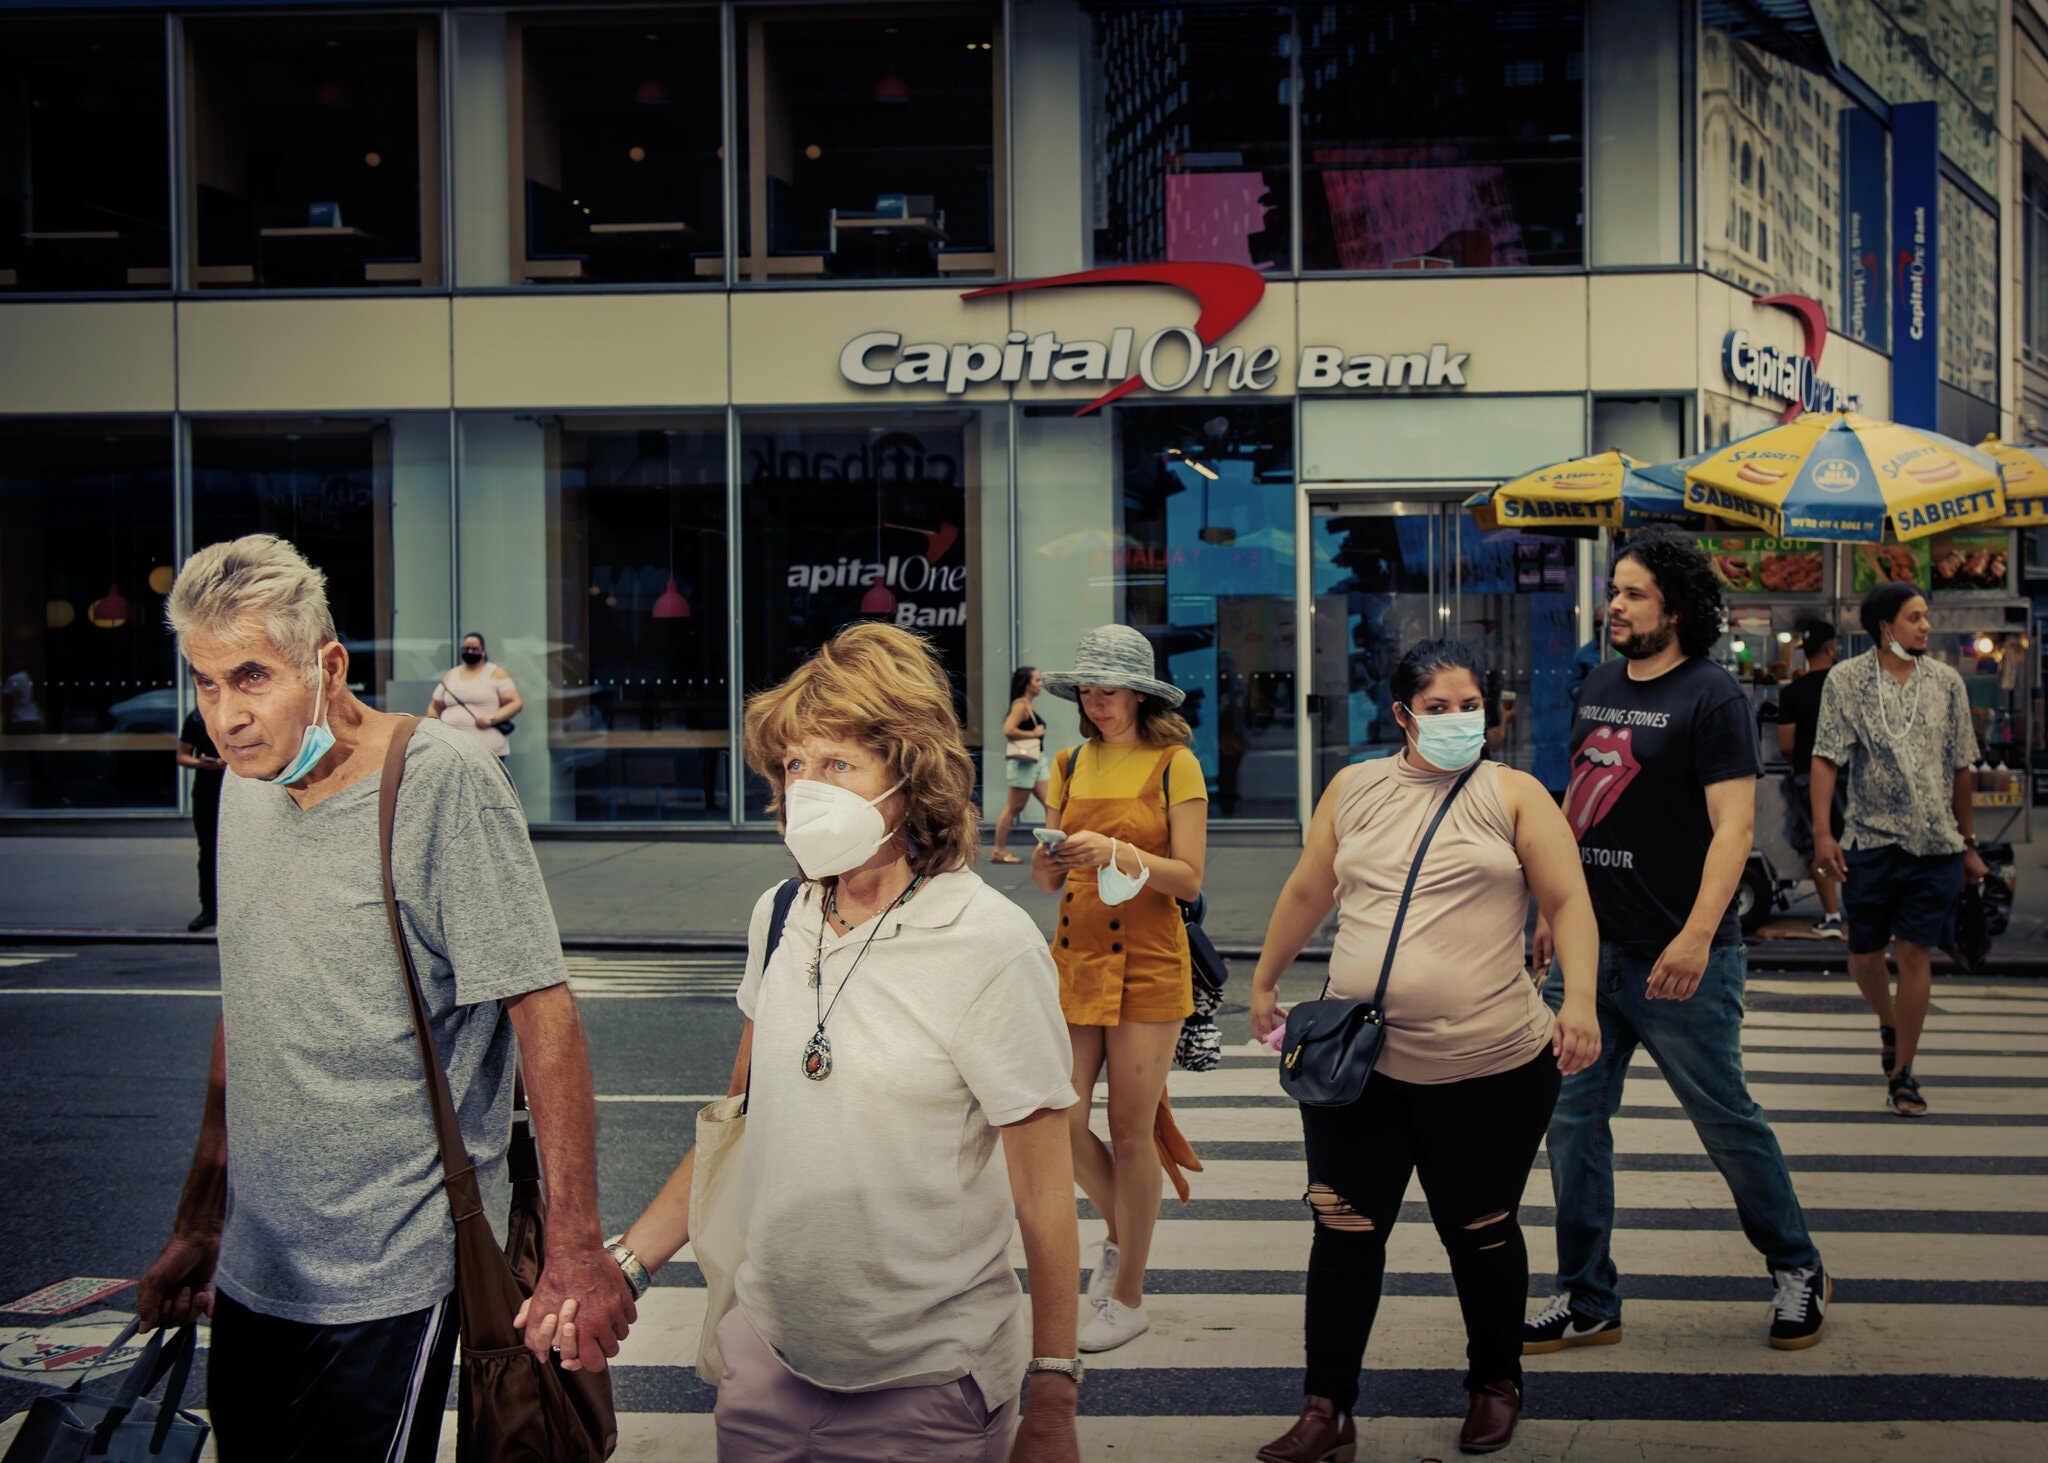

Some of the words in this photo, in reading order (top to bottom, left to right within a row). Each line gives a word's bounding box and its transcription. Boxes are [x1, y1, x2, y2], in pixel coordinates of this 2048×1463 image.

[1913, 206, 1926, 244] Bank
[838, 327, 1135, 395] Capital
[1297, 344, 1470, 390] Bank
[1504, 499, 1616, 519] SABRETT
[1689, 484, 1778, 526] SABRETT
[1898, 489, 1996, 532] SABRETT
[1751, 538, 1809, 551] FOOD
[786, 555, 900, 595] apital
[1582, 705, 1627, 724] ROLLING
[1624, 710, 1671, 728] STONES
[1592, 848, 1635, 870] TOUR
